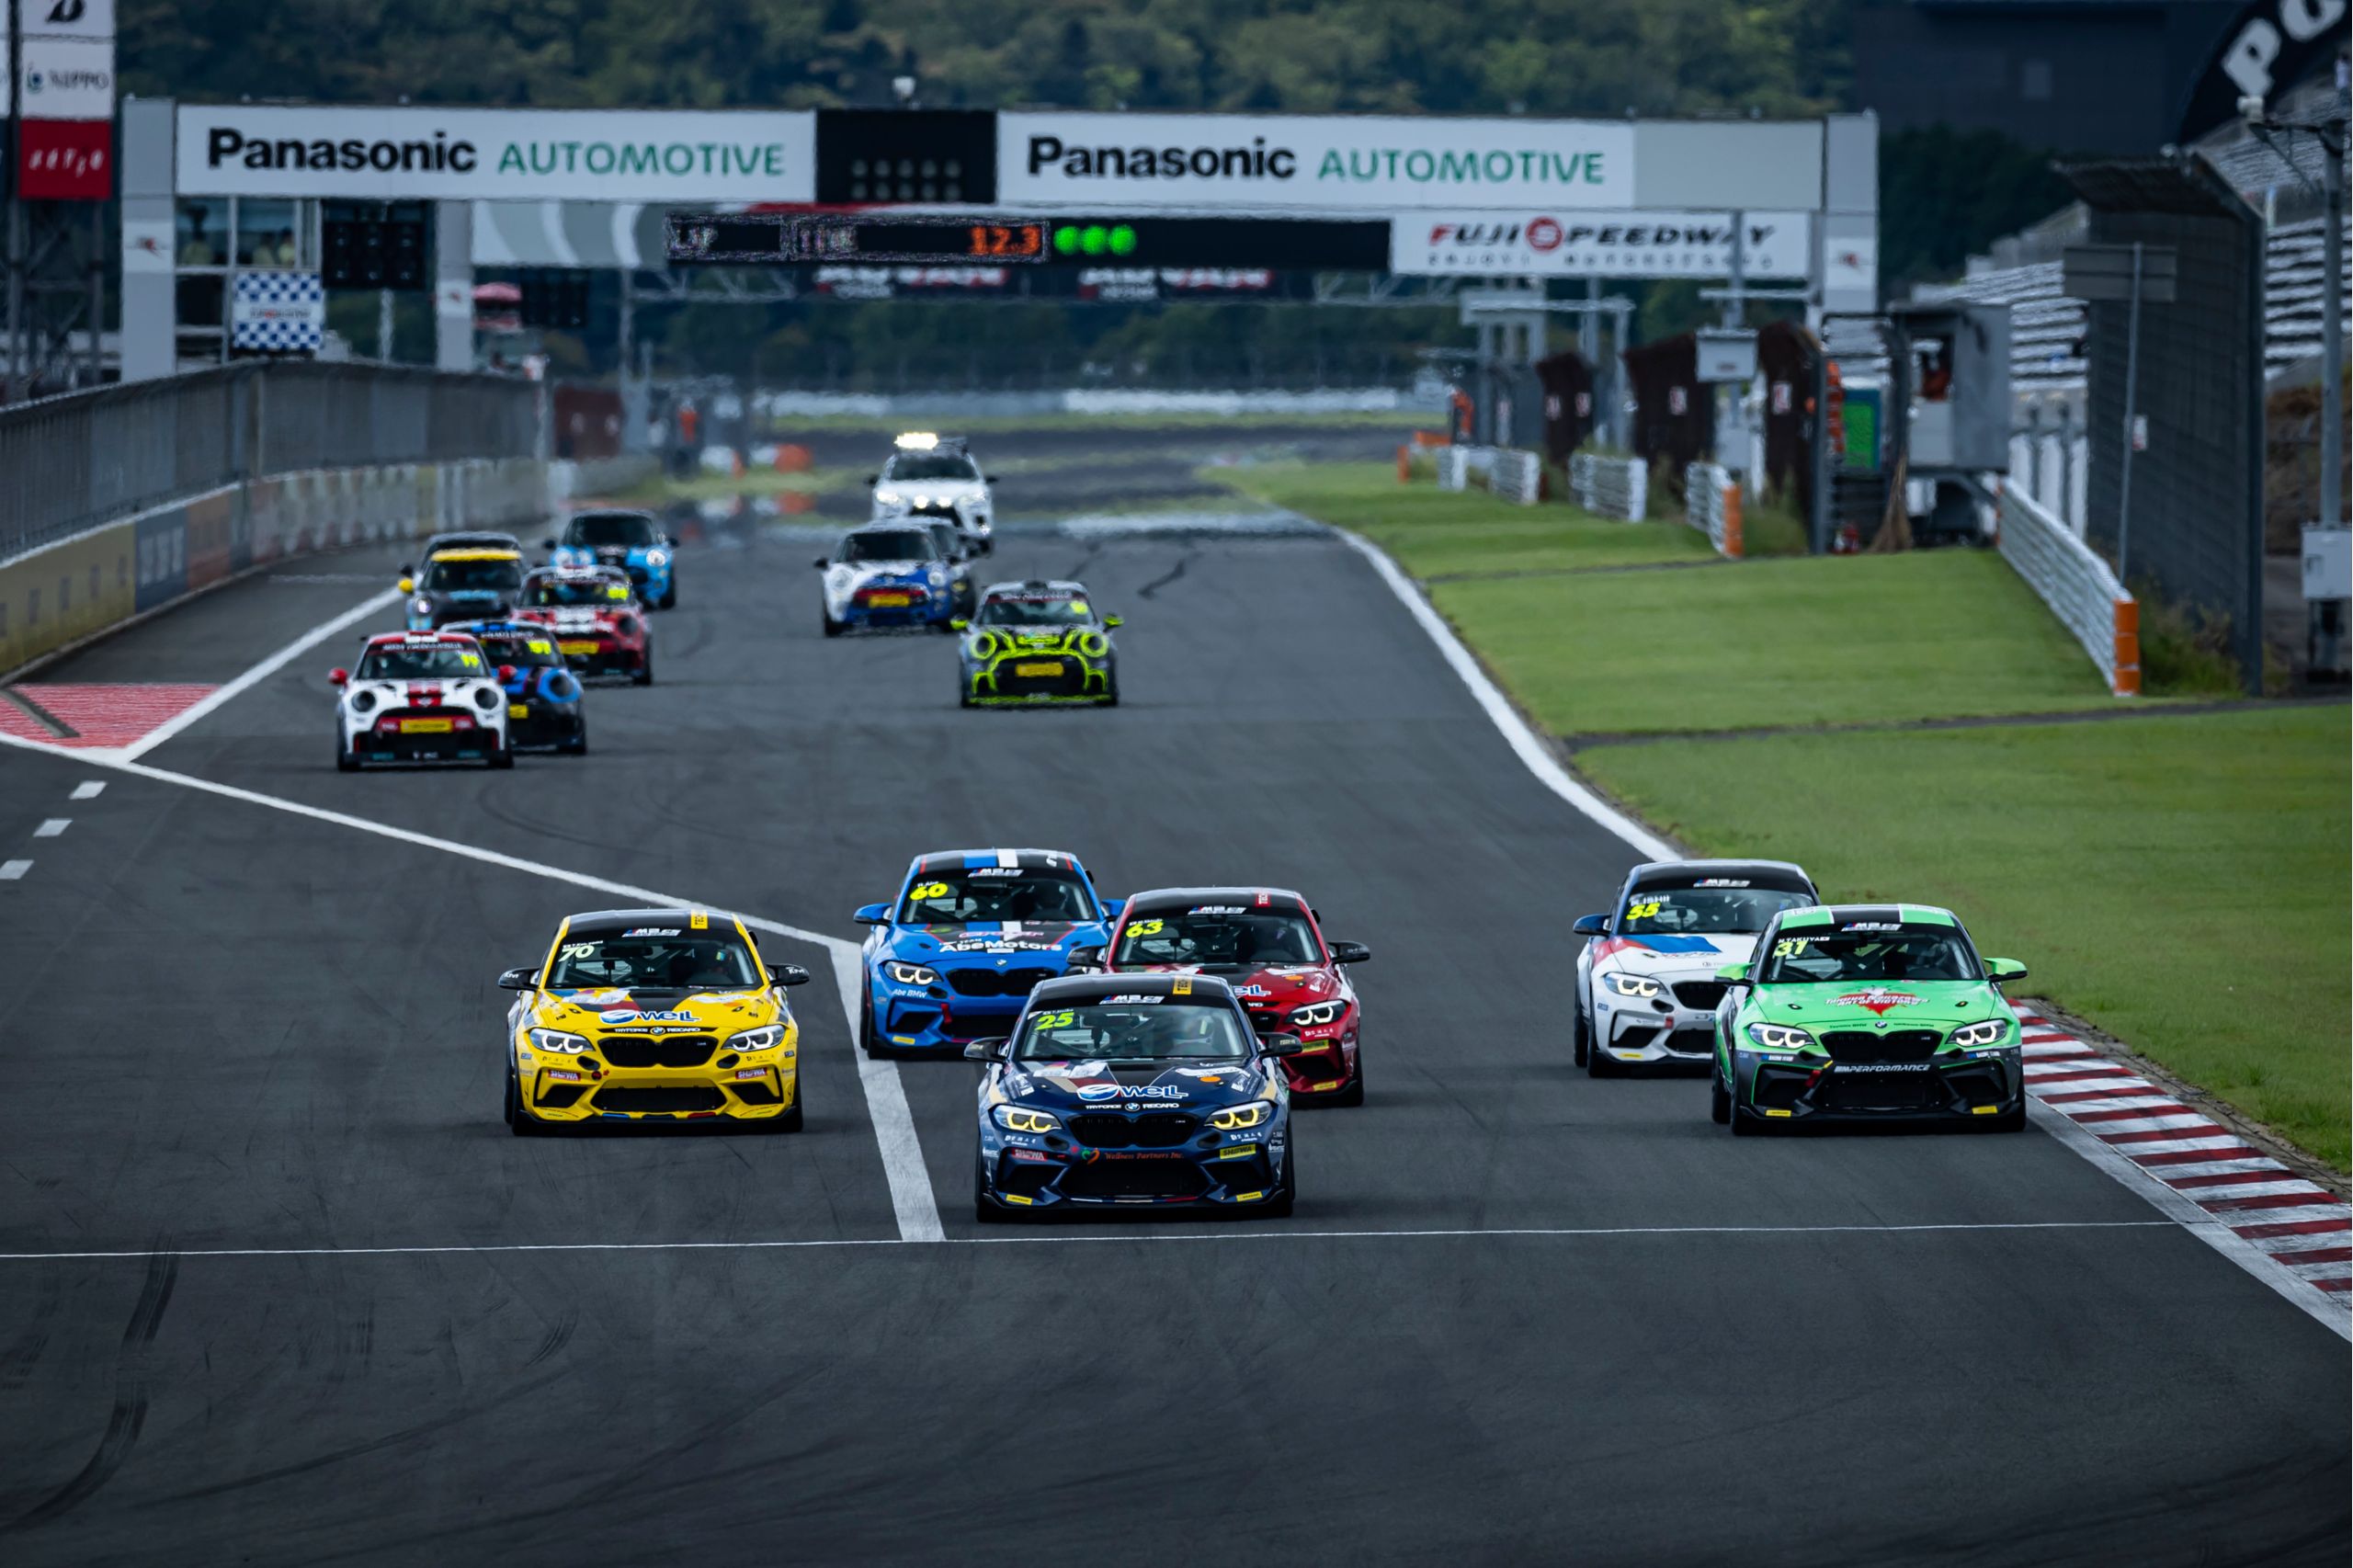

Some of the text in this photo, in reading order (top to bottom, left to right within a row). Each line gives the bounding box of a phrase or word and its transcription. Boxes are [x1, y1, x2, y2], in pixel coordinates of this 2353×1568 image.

[208, 127, 784, 176] Panasonic AUTOMOTIVE
[1028, 135, 1605, 184] Panasonic AUTOMOTIVE
[1428, 222, 1522, 247] FUJI
[909, 883, 949, 901] 60
[1626, 903, 1661, 920] 55
[1125, 921, 1164, 938] 63
[558, 945, 595, 962] 70
[1772, 940, 1809, 958] 31
[907, 989, 927, 998] BMW
[1035, 1012, 1074, 1030] 25
